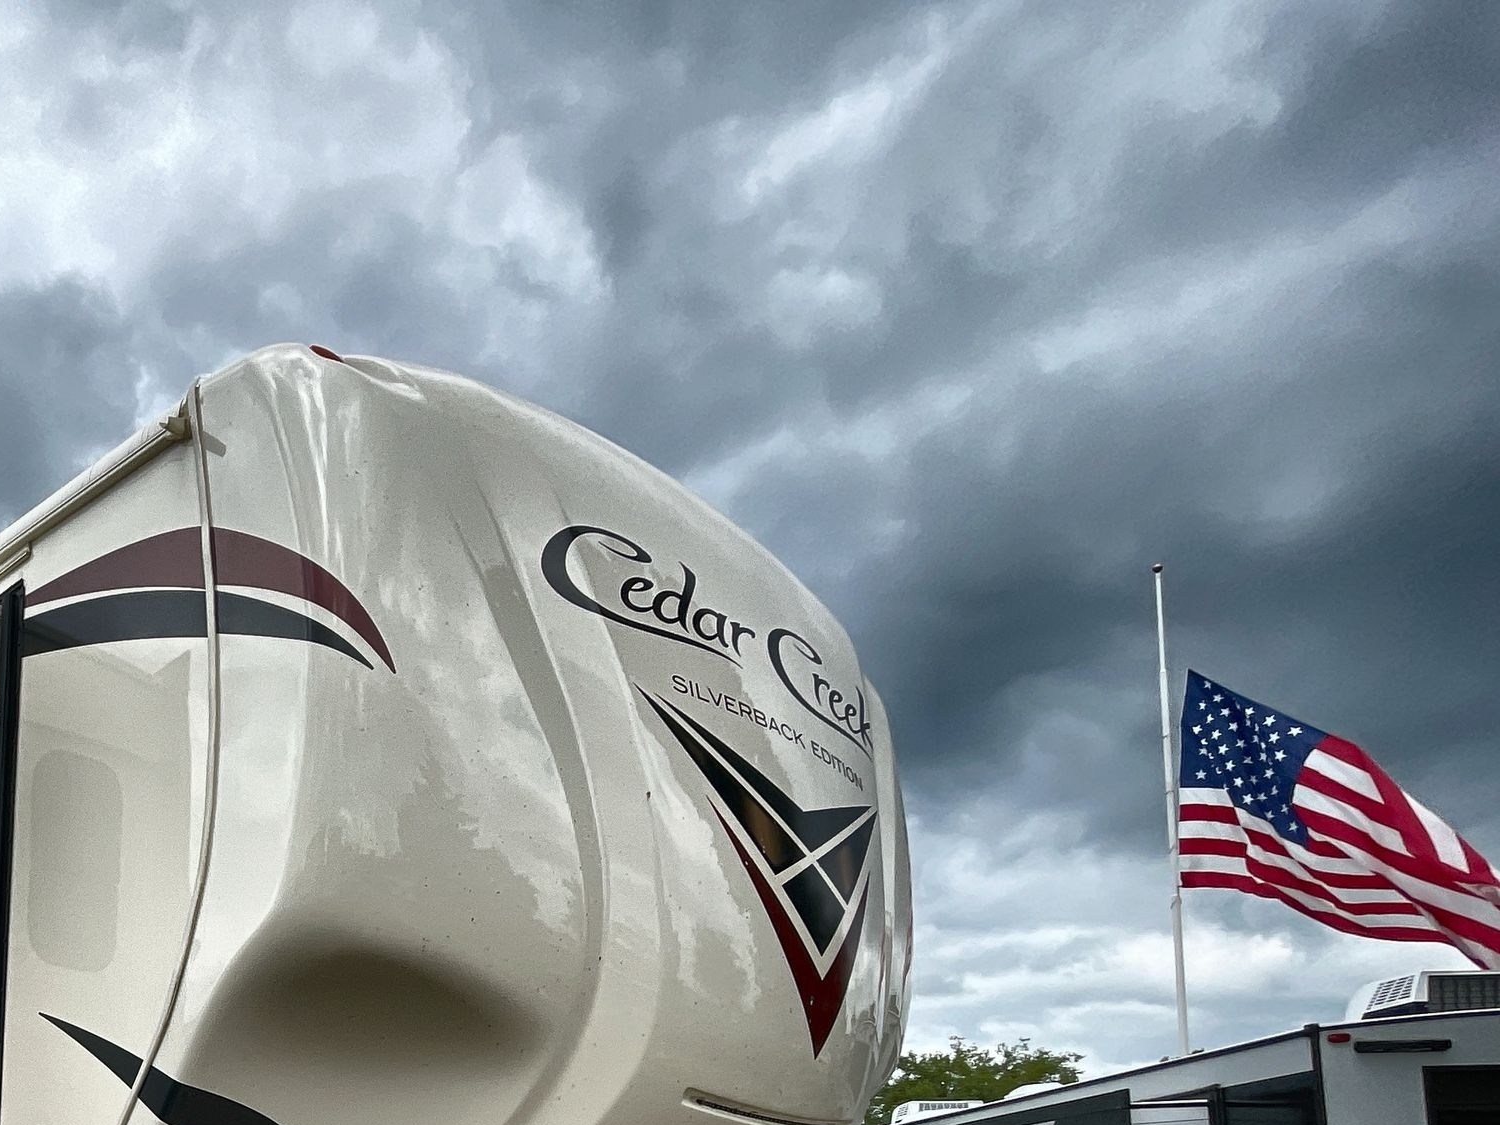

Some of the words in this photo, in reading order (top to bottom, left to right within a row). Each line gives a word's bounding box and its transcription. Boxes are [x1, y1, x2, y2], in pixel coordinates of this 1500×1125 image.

[541, 525, 755, 669] Cedar
[767, 628, 873, 763] Creek
[672, 675, 805, 749] SILVERBACK
[812, 741, 864, 791] EDITION
